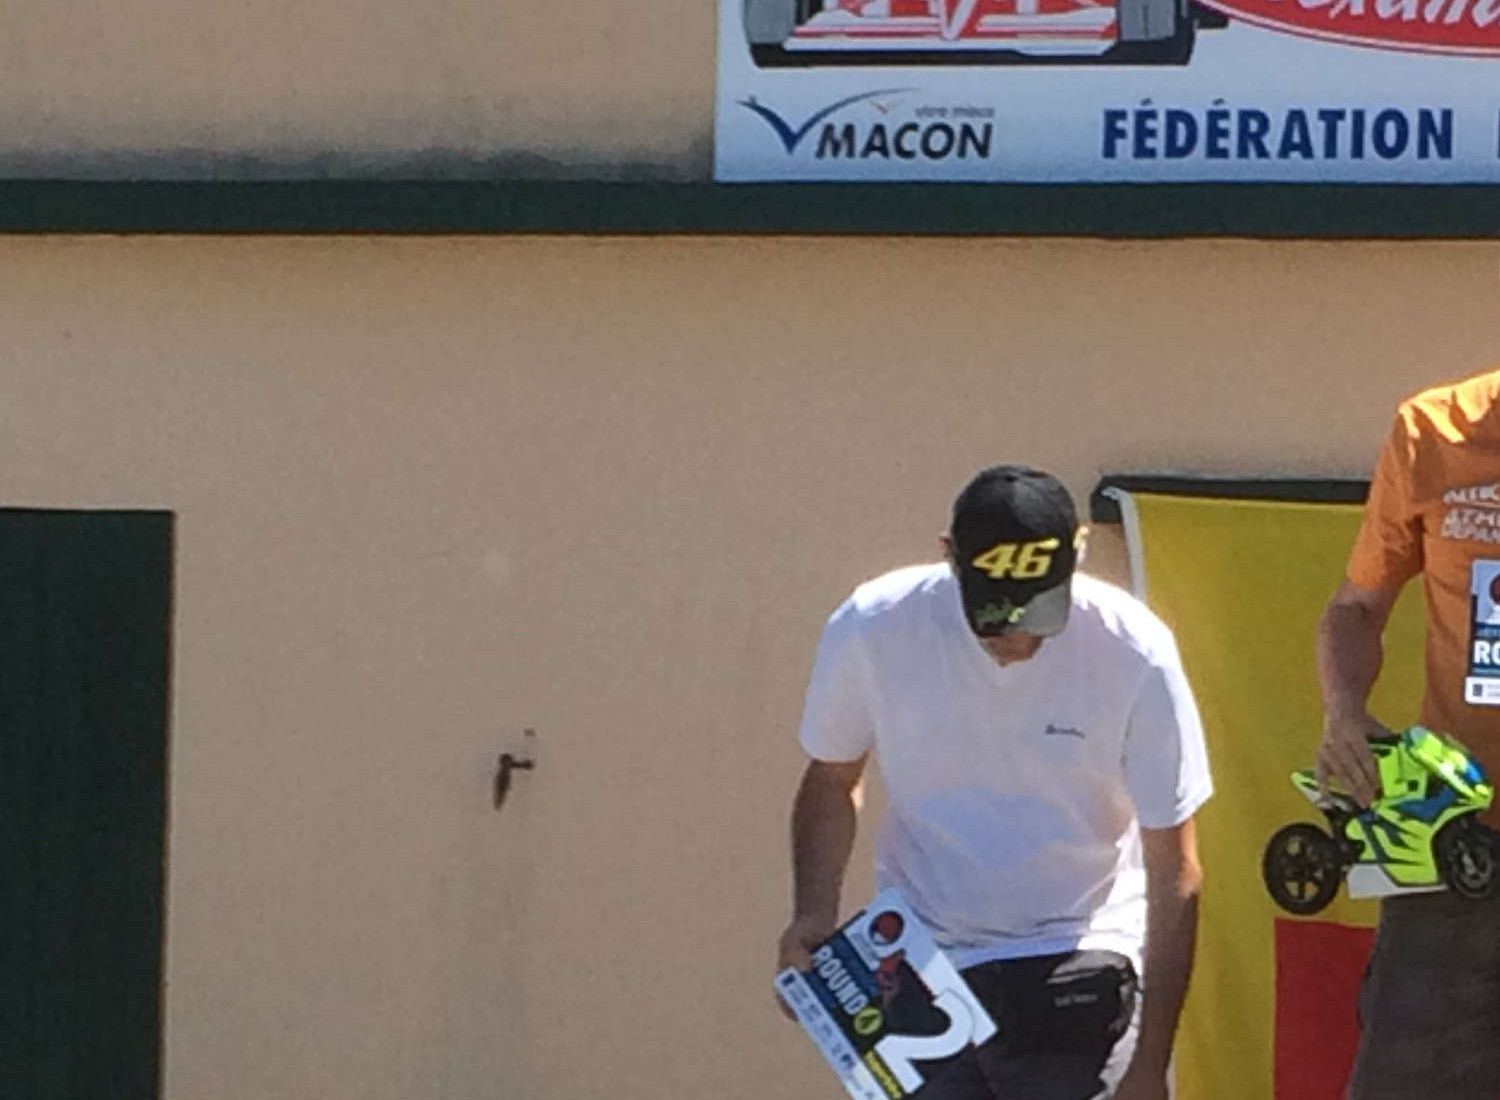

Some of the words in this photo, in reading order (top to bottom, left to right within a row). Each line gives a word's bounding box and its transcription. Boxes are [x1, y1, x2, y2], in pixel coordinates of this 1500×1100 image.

[815, 122, 993, 161] MACON
[1102, 99, 1454, 160] FÉDÉRATION
[972, 537, 1061, 579] 46
[811, 944, 869, 1016] ROUND
[873, 987, 975, 1095] 2
